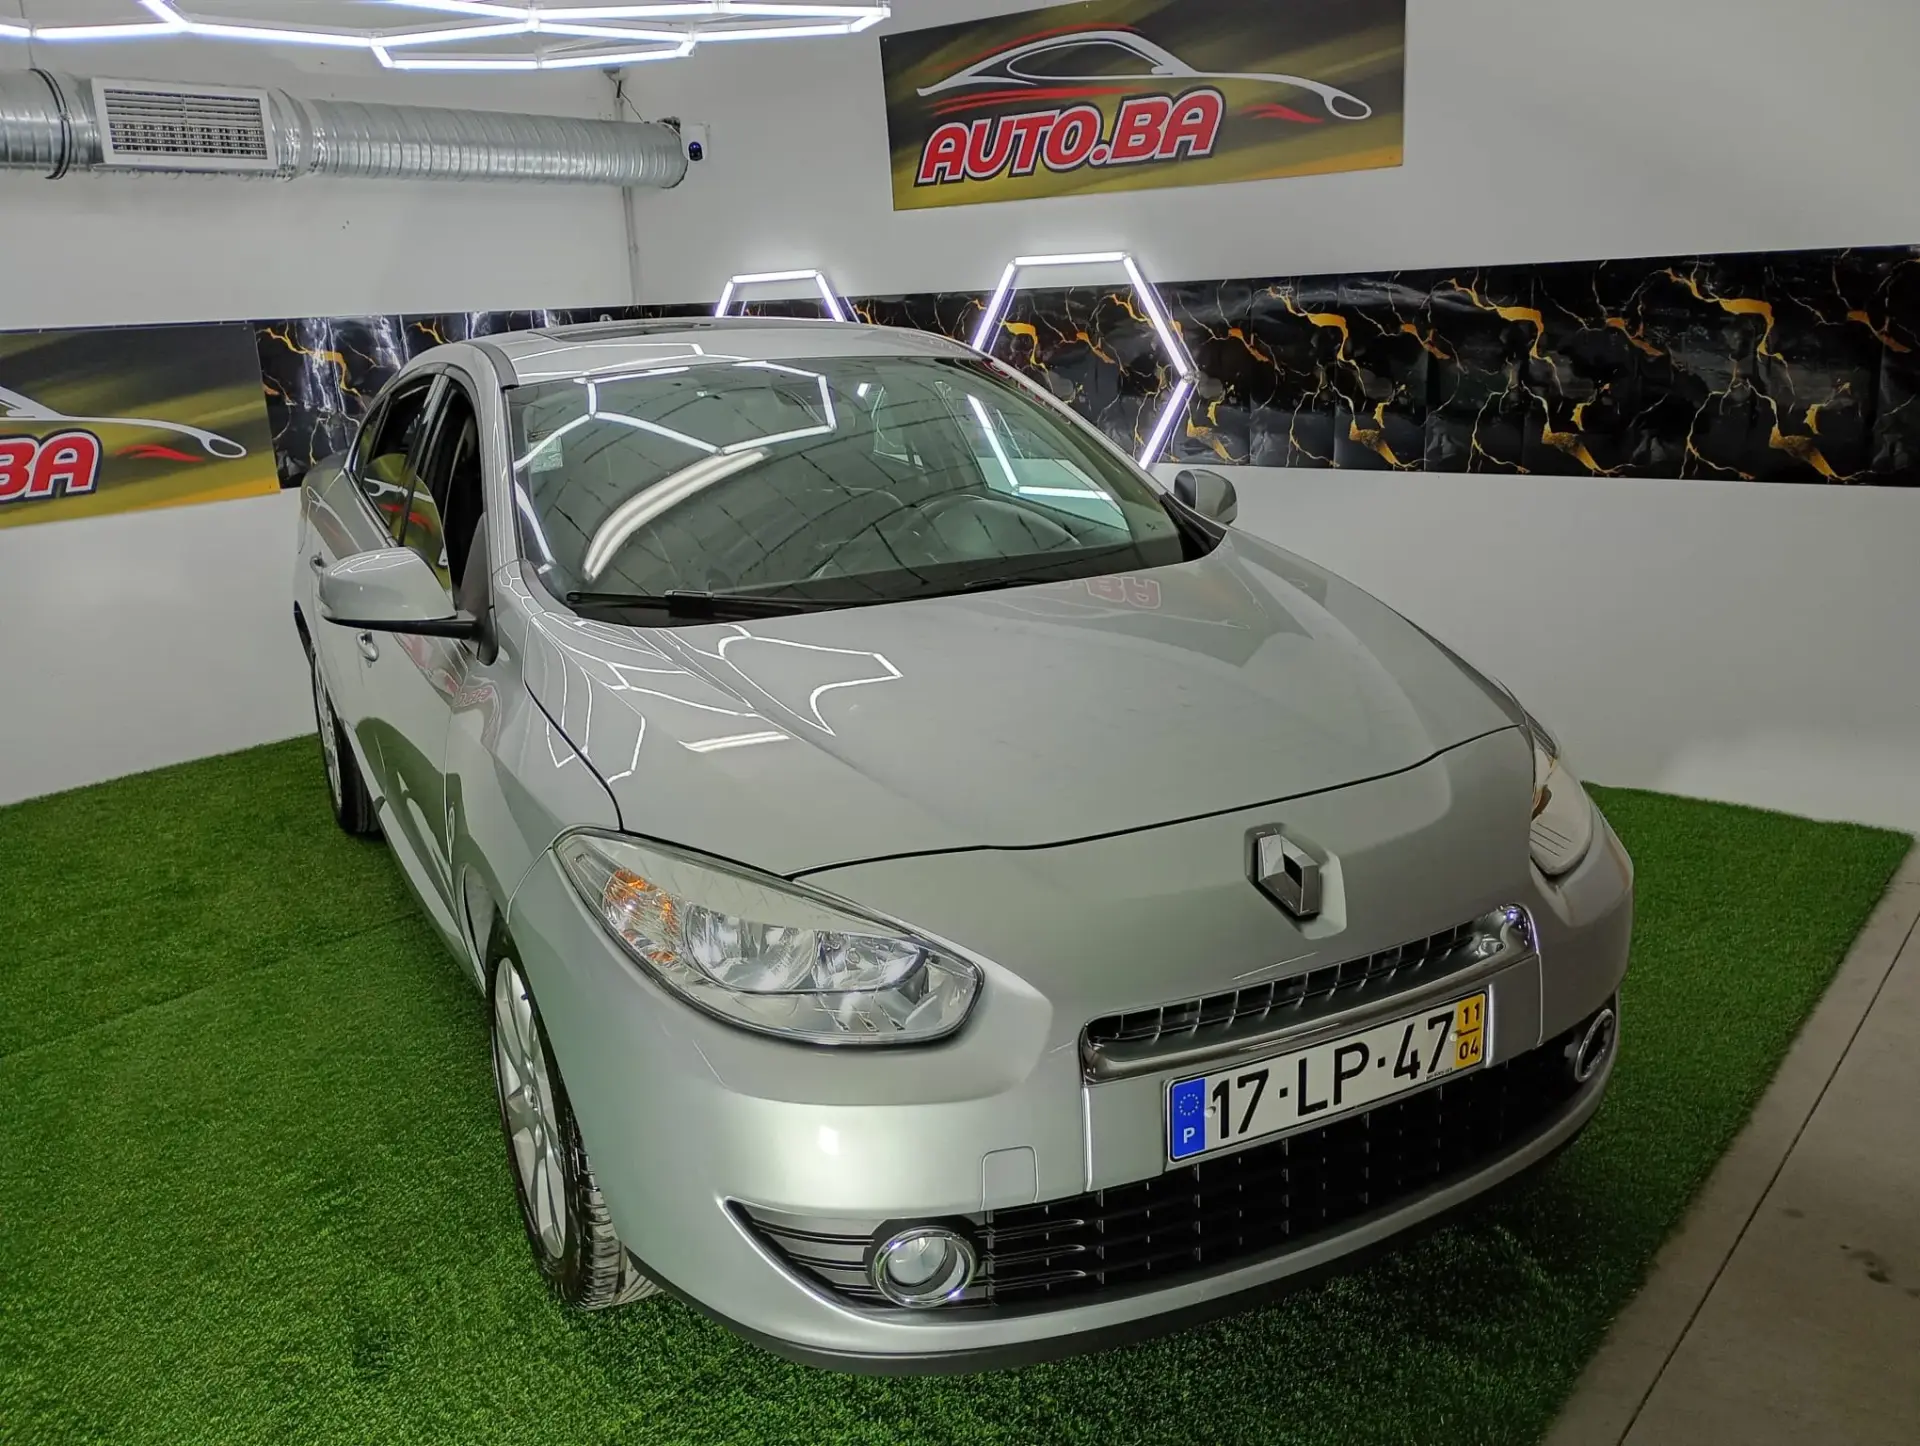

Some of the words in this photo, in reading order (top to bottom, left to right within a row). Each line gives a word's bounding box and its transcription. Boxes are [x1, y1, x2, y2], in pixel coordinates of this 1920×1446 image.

[916, 88, 1225, 185] AUTO.BA
[1463, 1002, 1480, 1024] 11
[1459, 1037, 1479, 1060] 04
[1183, 1126, 1196, 1144] P
